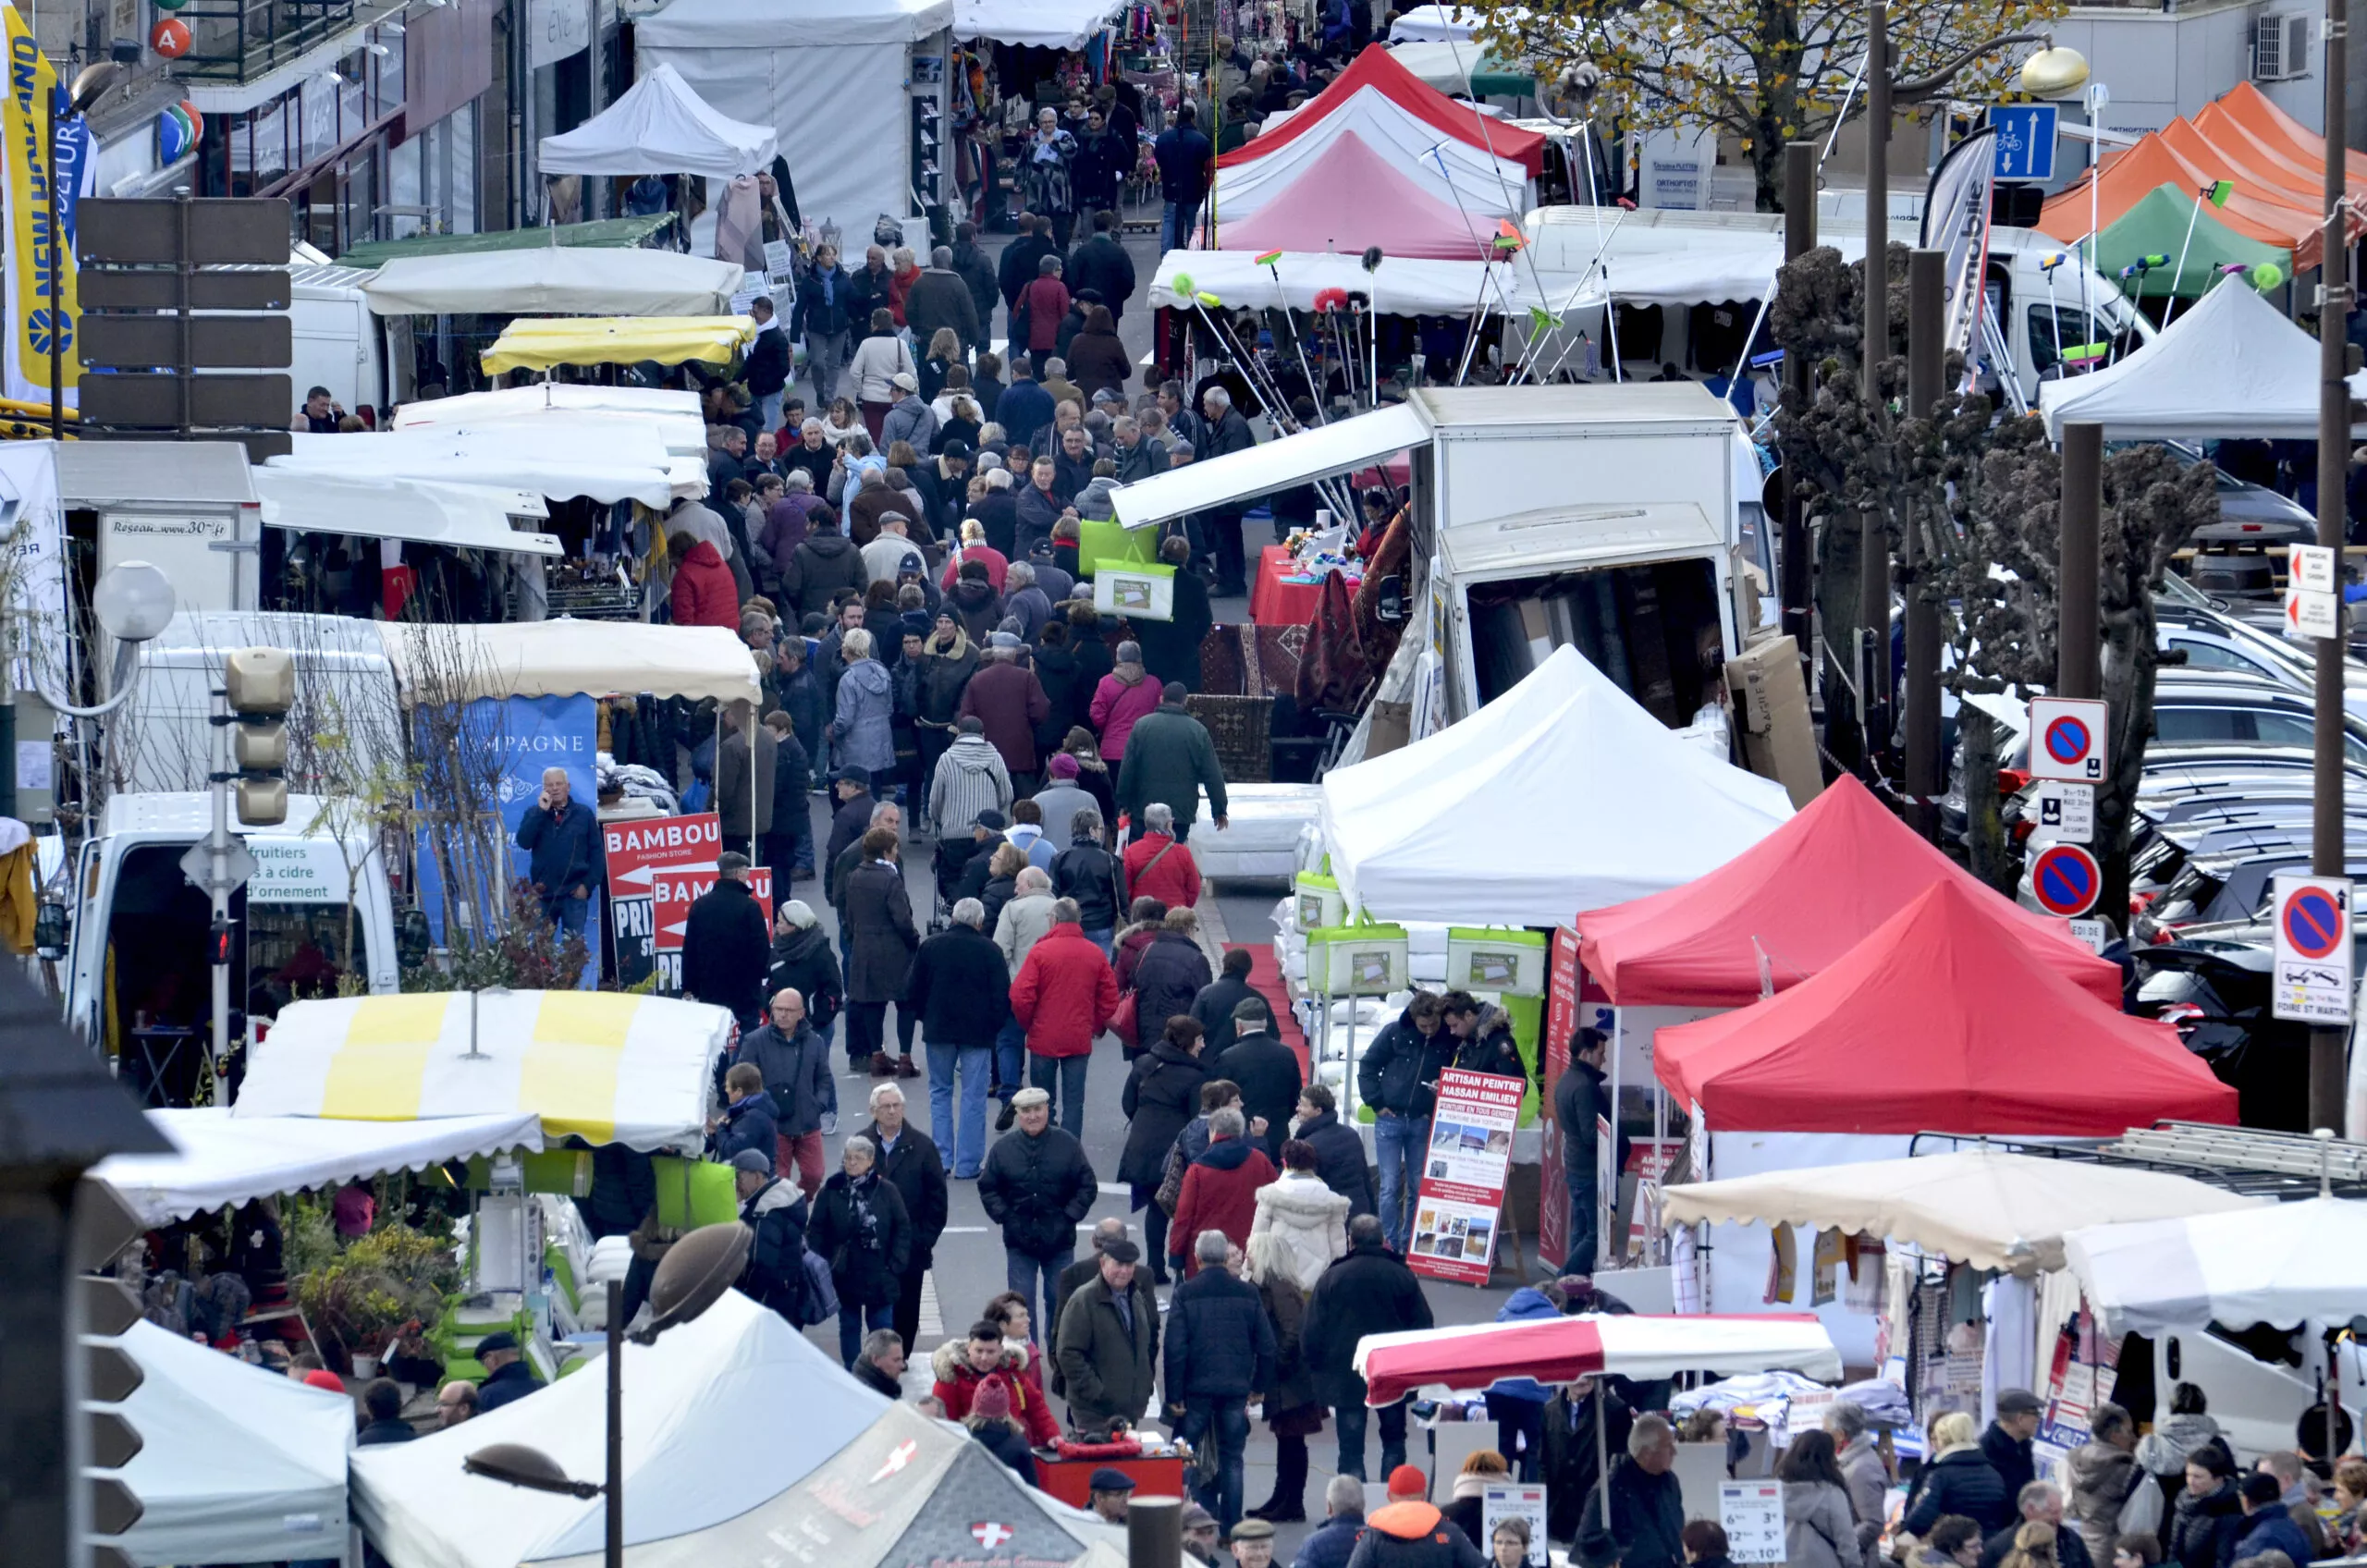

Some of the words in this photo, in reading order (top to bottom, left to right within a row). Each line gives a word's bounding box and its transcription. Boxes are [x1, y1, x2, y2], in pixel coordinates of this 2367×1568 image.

[607, 822, 719, 852] BAMBOU
[249, 846, 307, 859] fruitiers
[636, 851, 668, 861] FASHION
[668, 849, 693, 858] STORE
[265, 865, 274, 878] à
[278, 865, 314, 878] cidre
[655, 877, 770, 903] BAMU
[1442, 1072, 1480, 1086] ARTISAN
[1483, 1078, 1522, 1092] PEINTRE
[1441, 1085, 1478, 1099] HASSAN
[1480, 1091, 1517, 1105] EMILIEN
